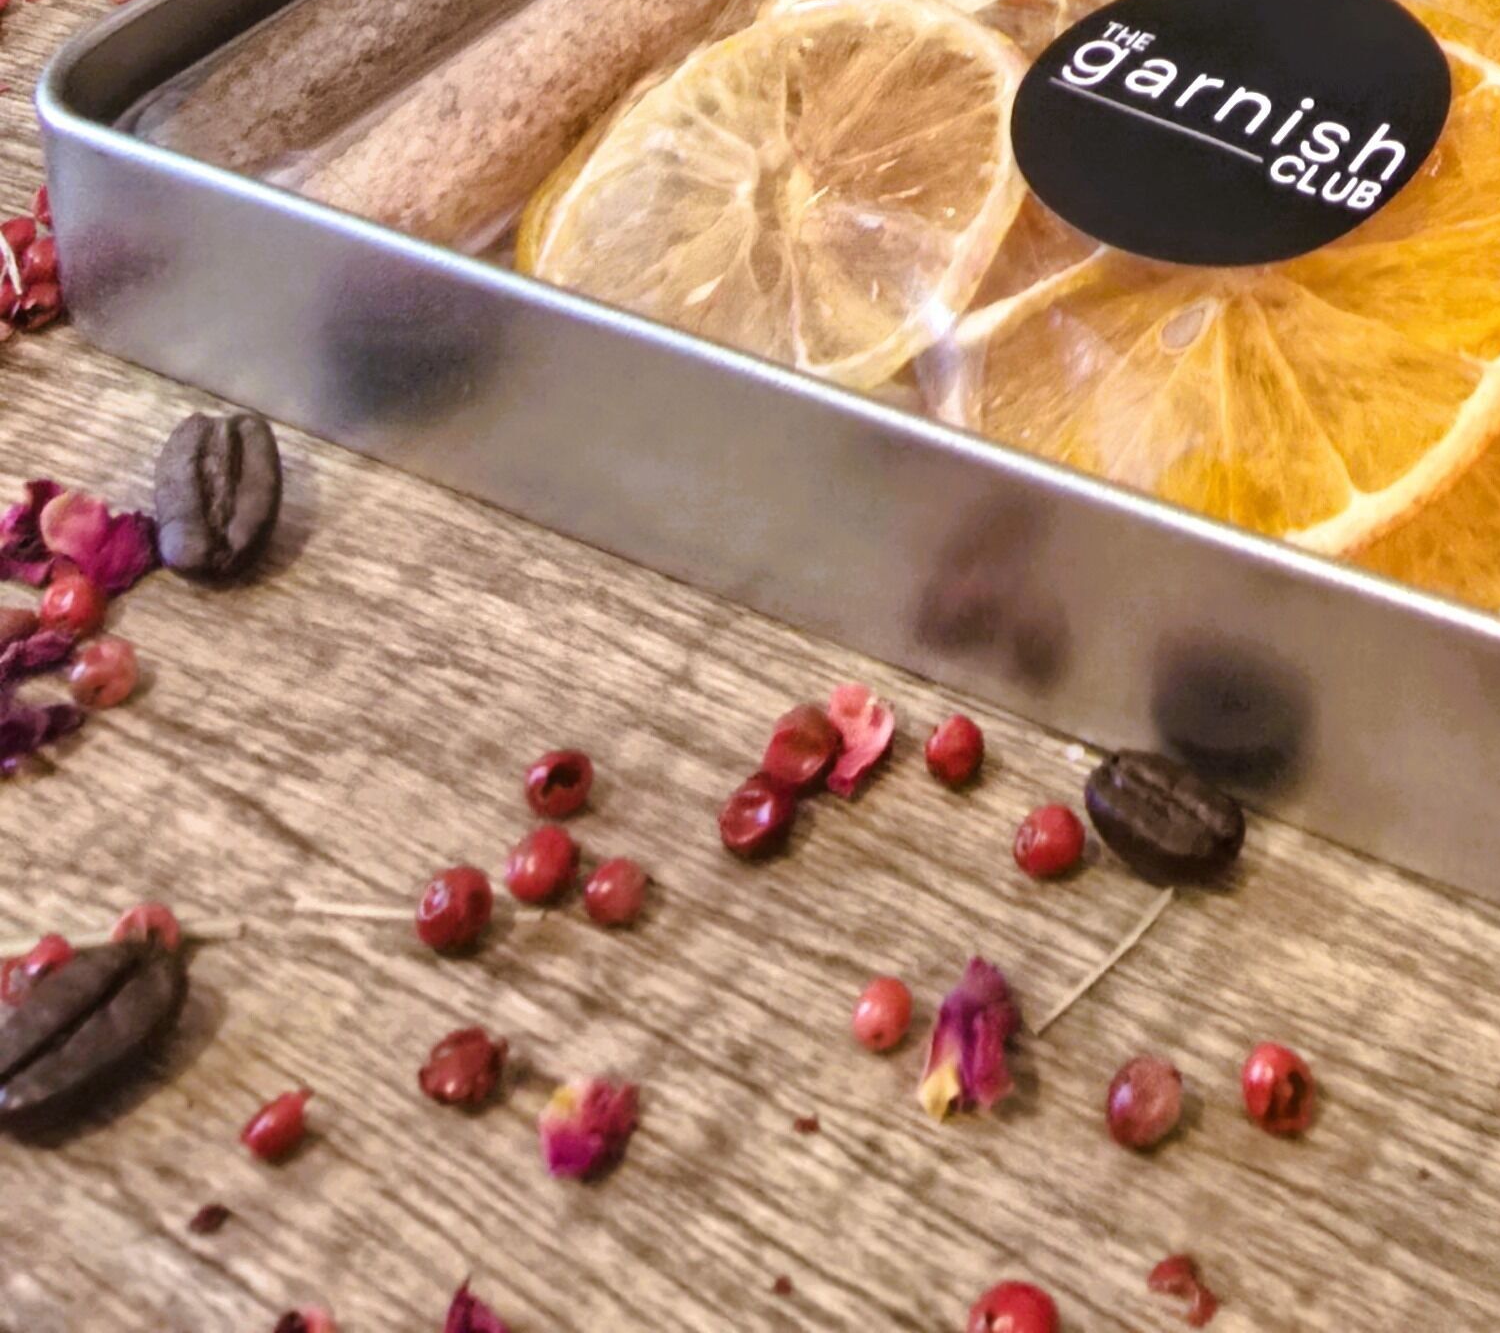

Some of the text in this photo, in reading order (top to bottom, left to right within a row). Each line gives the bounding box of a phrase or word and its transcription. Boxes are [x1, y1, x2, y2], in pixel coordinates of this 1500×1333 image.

[1104, 22, 1155, 51] THE
[1062, 40, 1406, 182] garnish
[1270, 155, 1382, 210] CLUB
